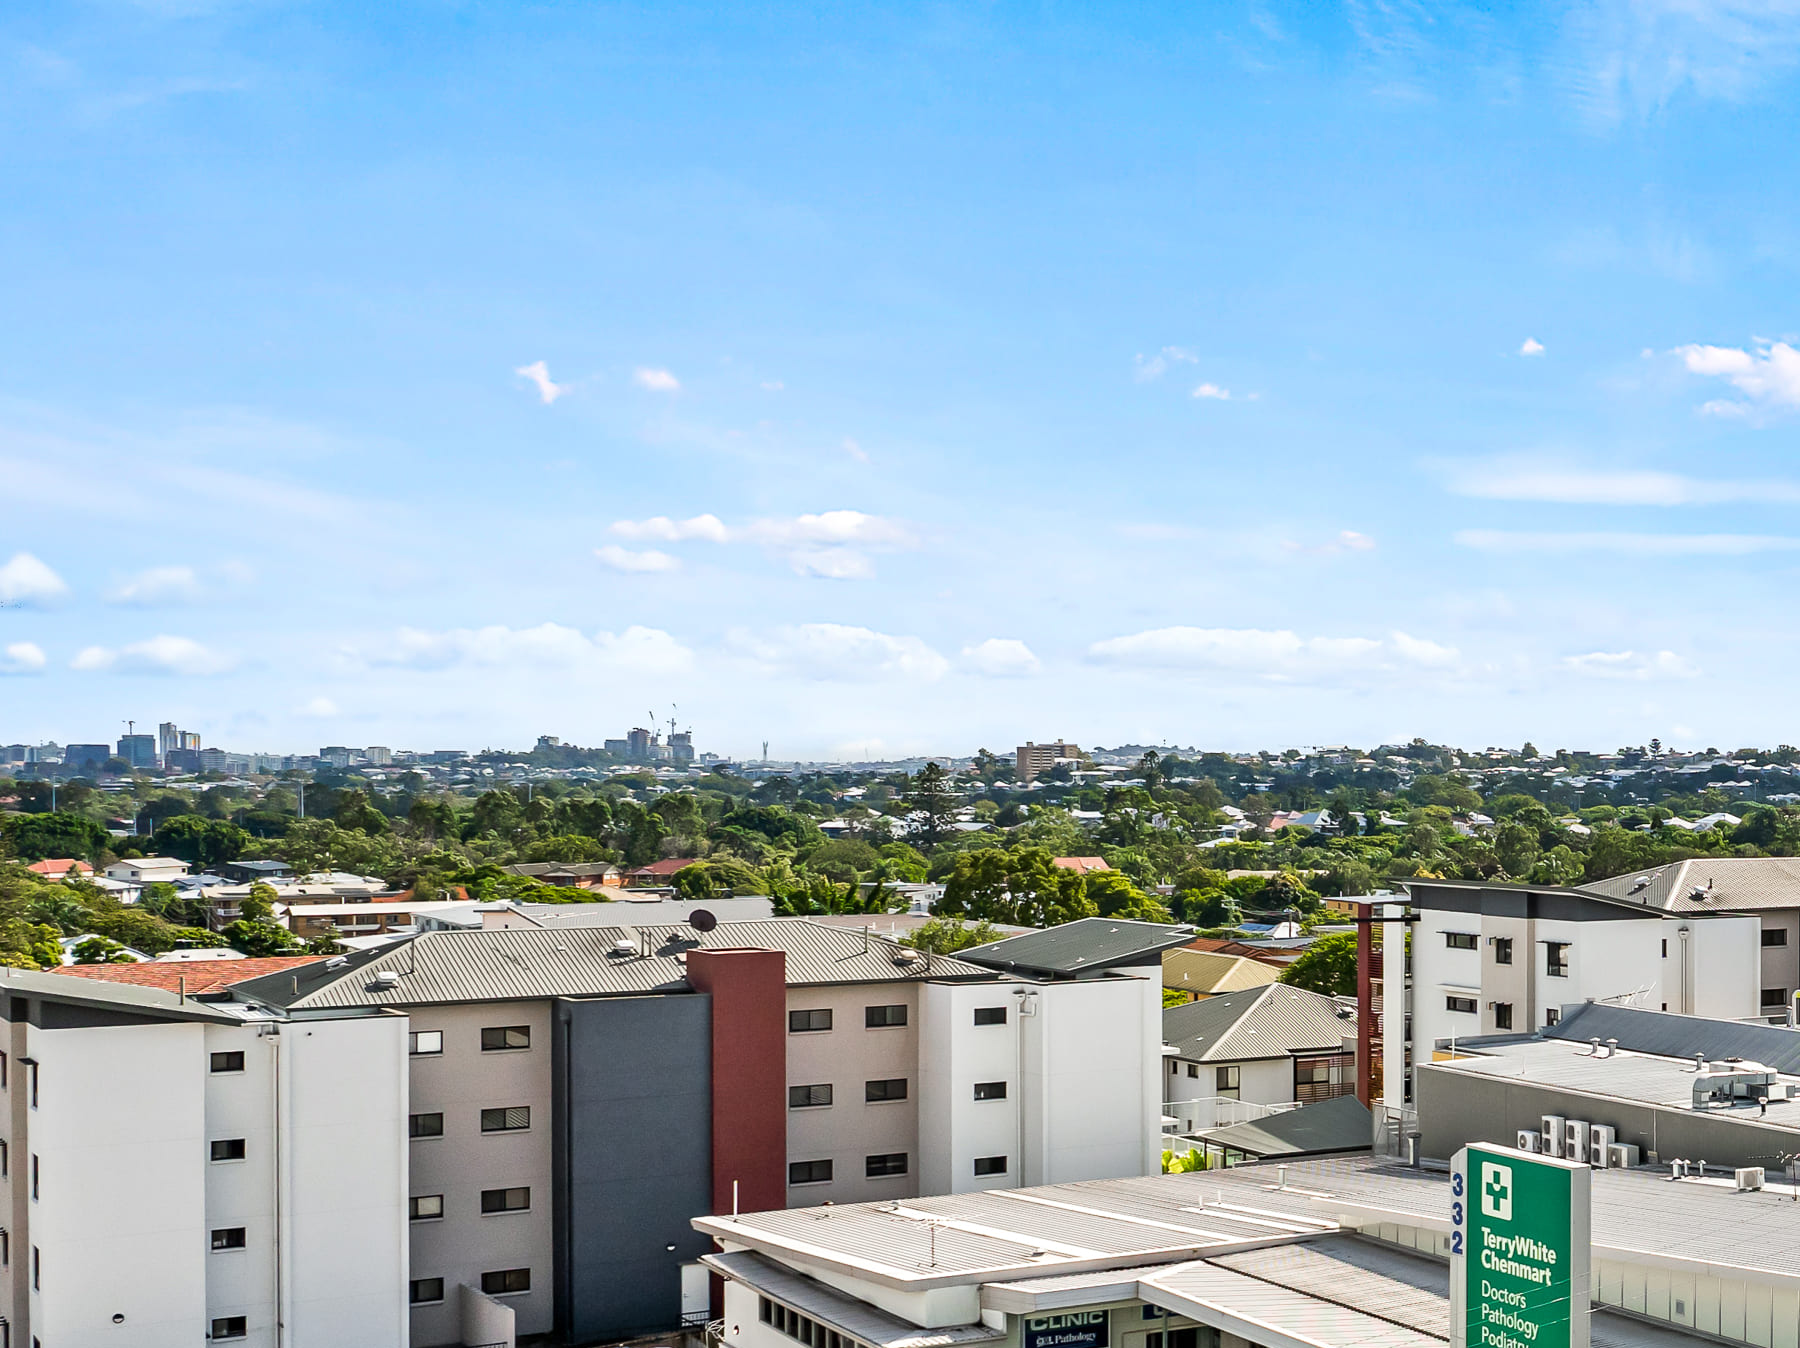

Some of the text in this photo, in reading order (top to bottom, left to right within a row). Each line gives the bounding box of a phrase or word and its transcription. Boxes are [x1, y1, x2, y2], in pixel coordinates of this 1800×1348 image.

[1452, 1172, 1464, 1255] 332
[1481, 1226, 1557, 1264] TerryWhite
[1481, 1249, 1552, 1286] Chemmart
[1481, 1280, 1527, 1308] Doctors
[1030, 1311, 1104, 1331] CLINIC
[1055, 1332, 1097, 1345] Pathology
[1481, 1303, 1539, 1340] Pathology
